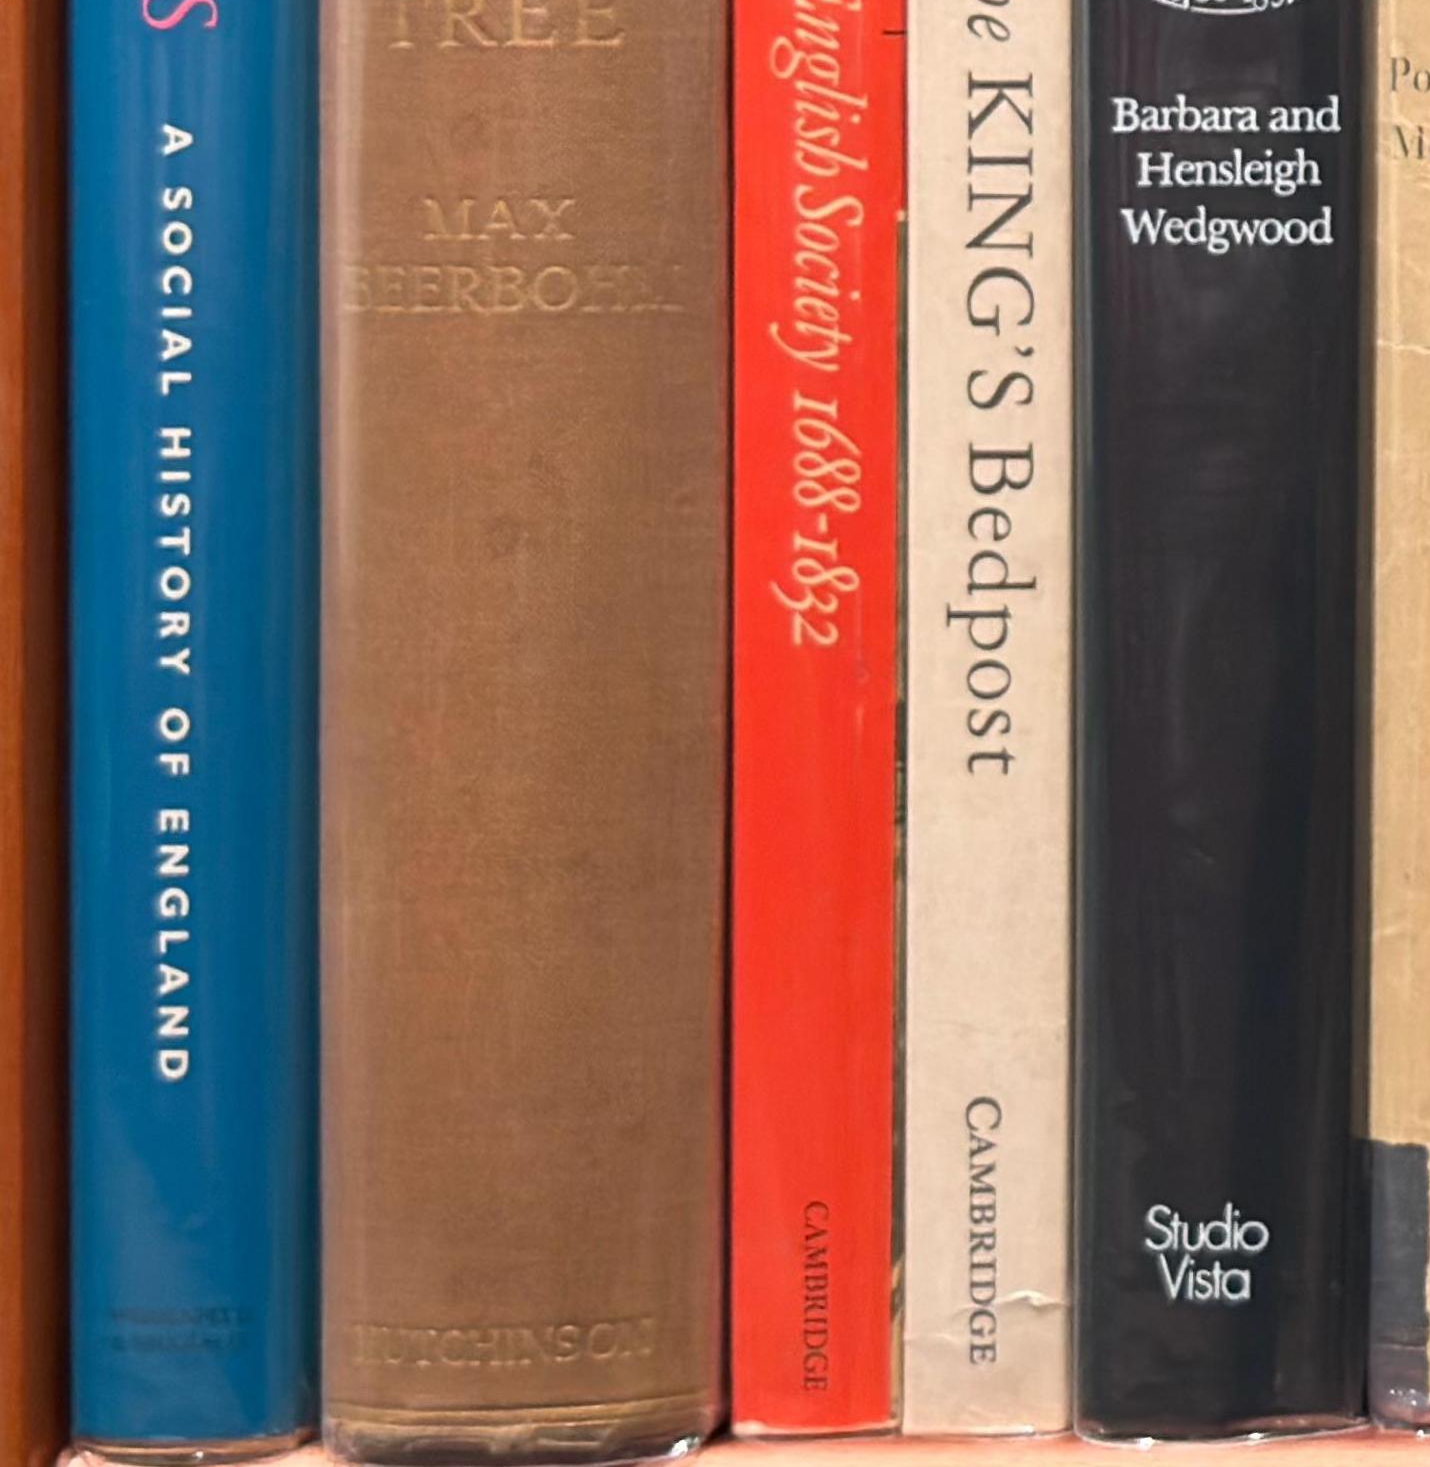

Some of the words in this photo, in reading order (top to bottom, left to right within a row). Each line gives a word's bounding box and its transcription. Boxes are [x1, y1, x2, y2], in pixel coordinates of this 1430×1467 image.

[159, 124, 193, 156] A
[1111, 97, 1258, 133] Barbara
[1269, 97, 1341, 133] and
[1136, 150, 1321, 195] Hensleigh
[157, 187, 195, 393] SOCIAL
[424, 198, 576, 240] MAX
[770, 191, 864, 372] Society
[965, 71, 1035, 411] KING'S
[1121, 208, 1334, 254] Wedgwood
[156, 426, 193, 677] HISTORY
[770, 395, 862, 647] 1688-1832
[946, 443, 1038, 774] Bedpost
[156, 707, 192, 778] OF
[155, 806, 192, 1081] ENGLAND
[803, 1200, 829, 1392] CAMBRIDGE
[965, 1095, 1002, 1364] CAMBRIDGE
[1145, 1203, 1269, 1254] Studio
[1159, 1258, 1251, 1301] Vista
